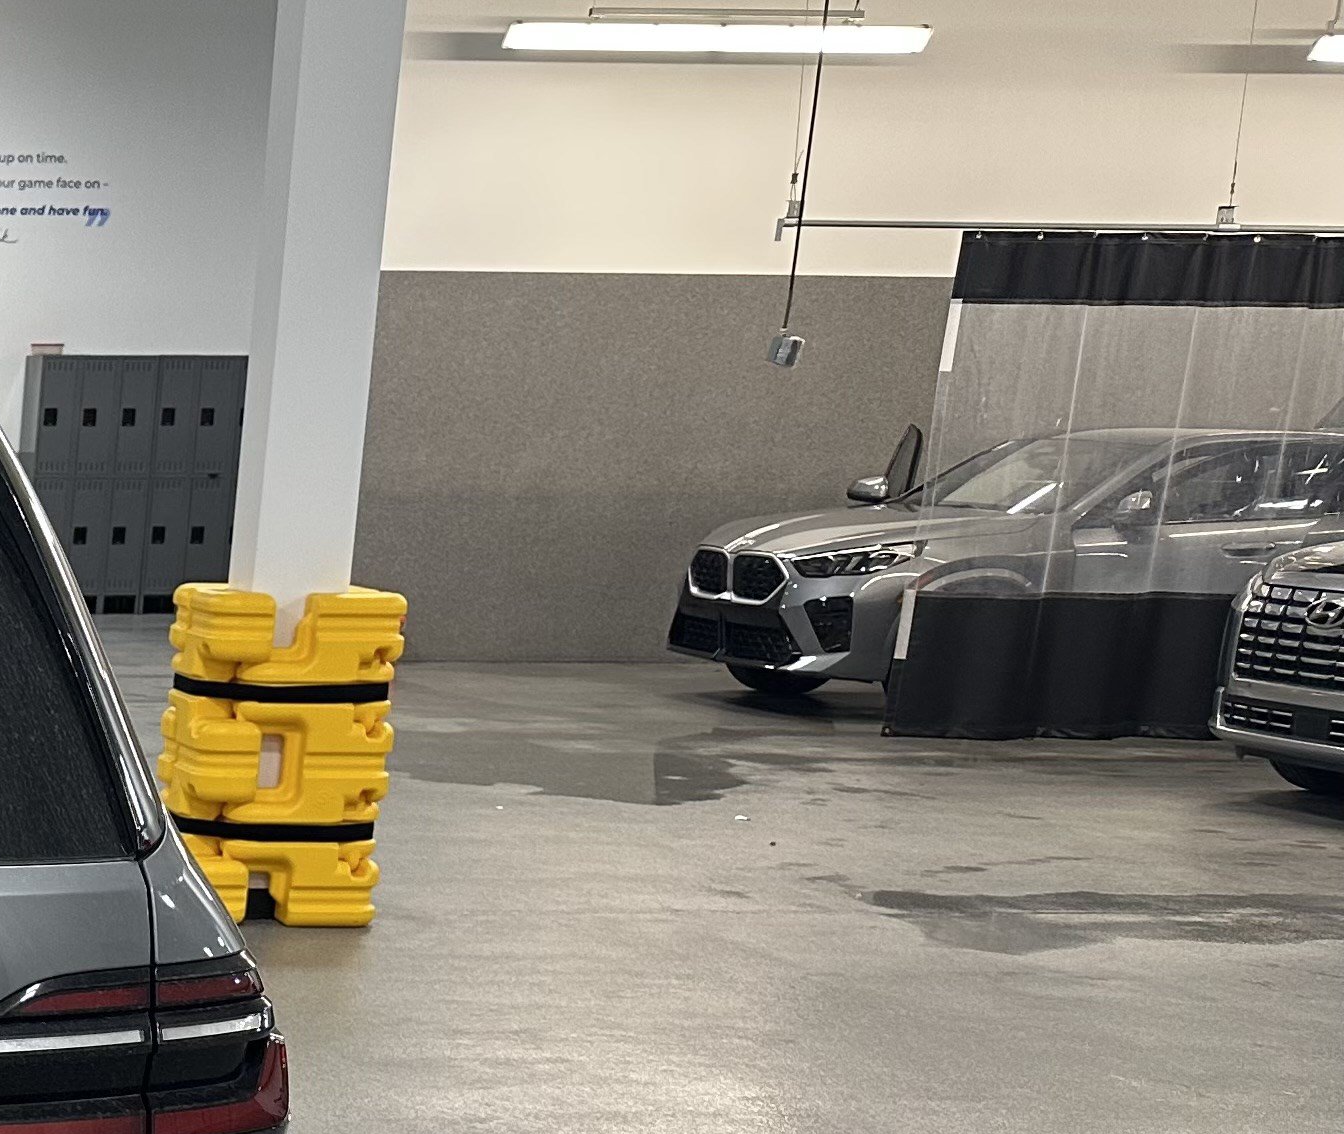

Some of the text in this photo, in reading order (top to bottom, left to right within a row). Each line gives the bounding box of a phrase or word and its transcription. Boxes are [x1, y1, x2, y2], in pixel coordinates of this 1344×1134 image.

[17, 154, 34, 164] on
[36, 152, 68, 164] time.
[18, 179, 54, 191] game
[56, 177, 82, 189] face
[84, 179, 101, 189] on
[20, 205, 46, 216] and
[48, 205, 80, 216] have
